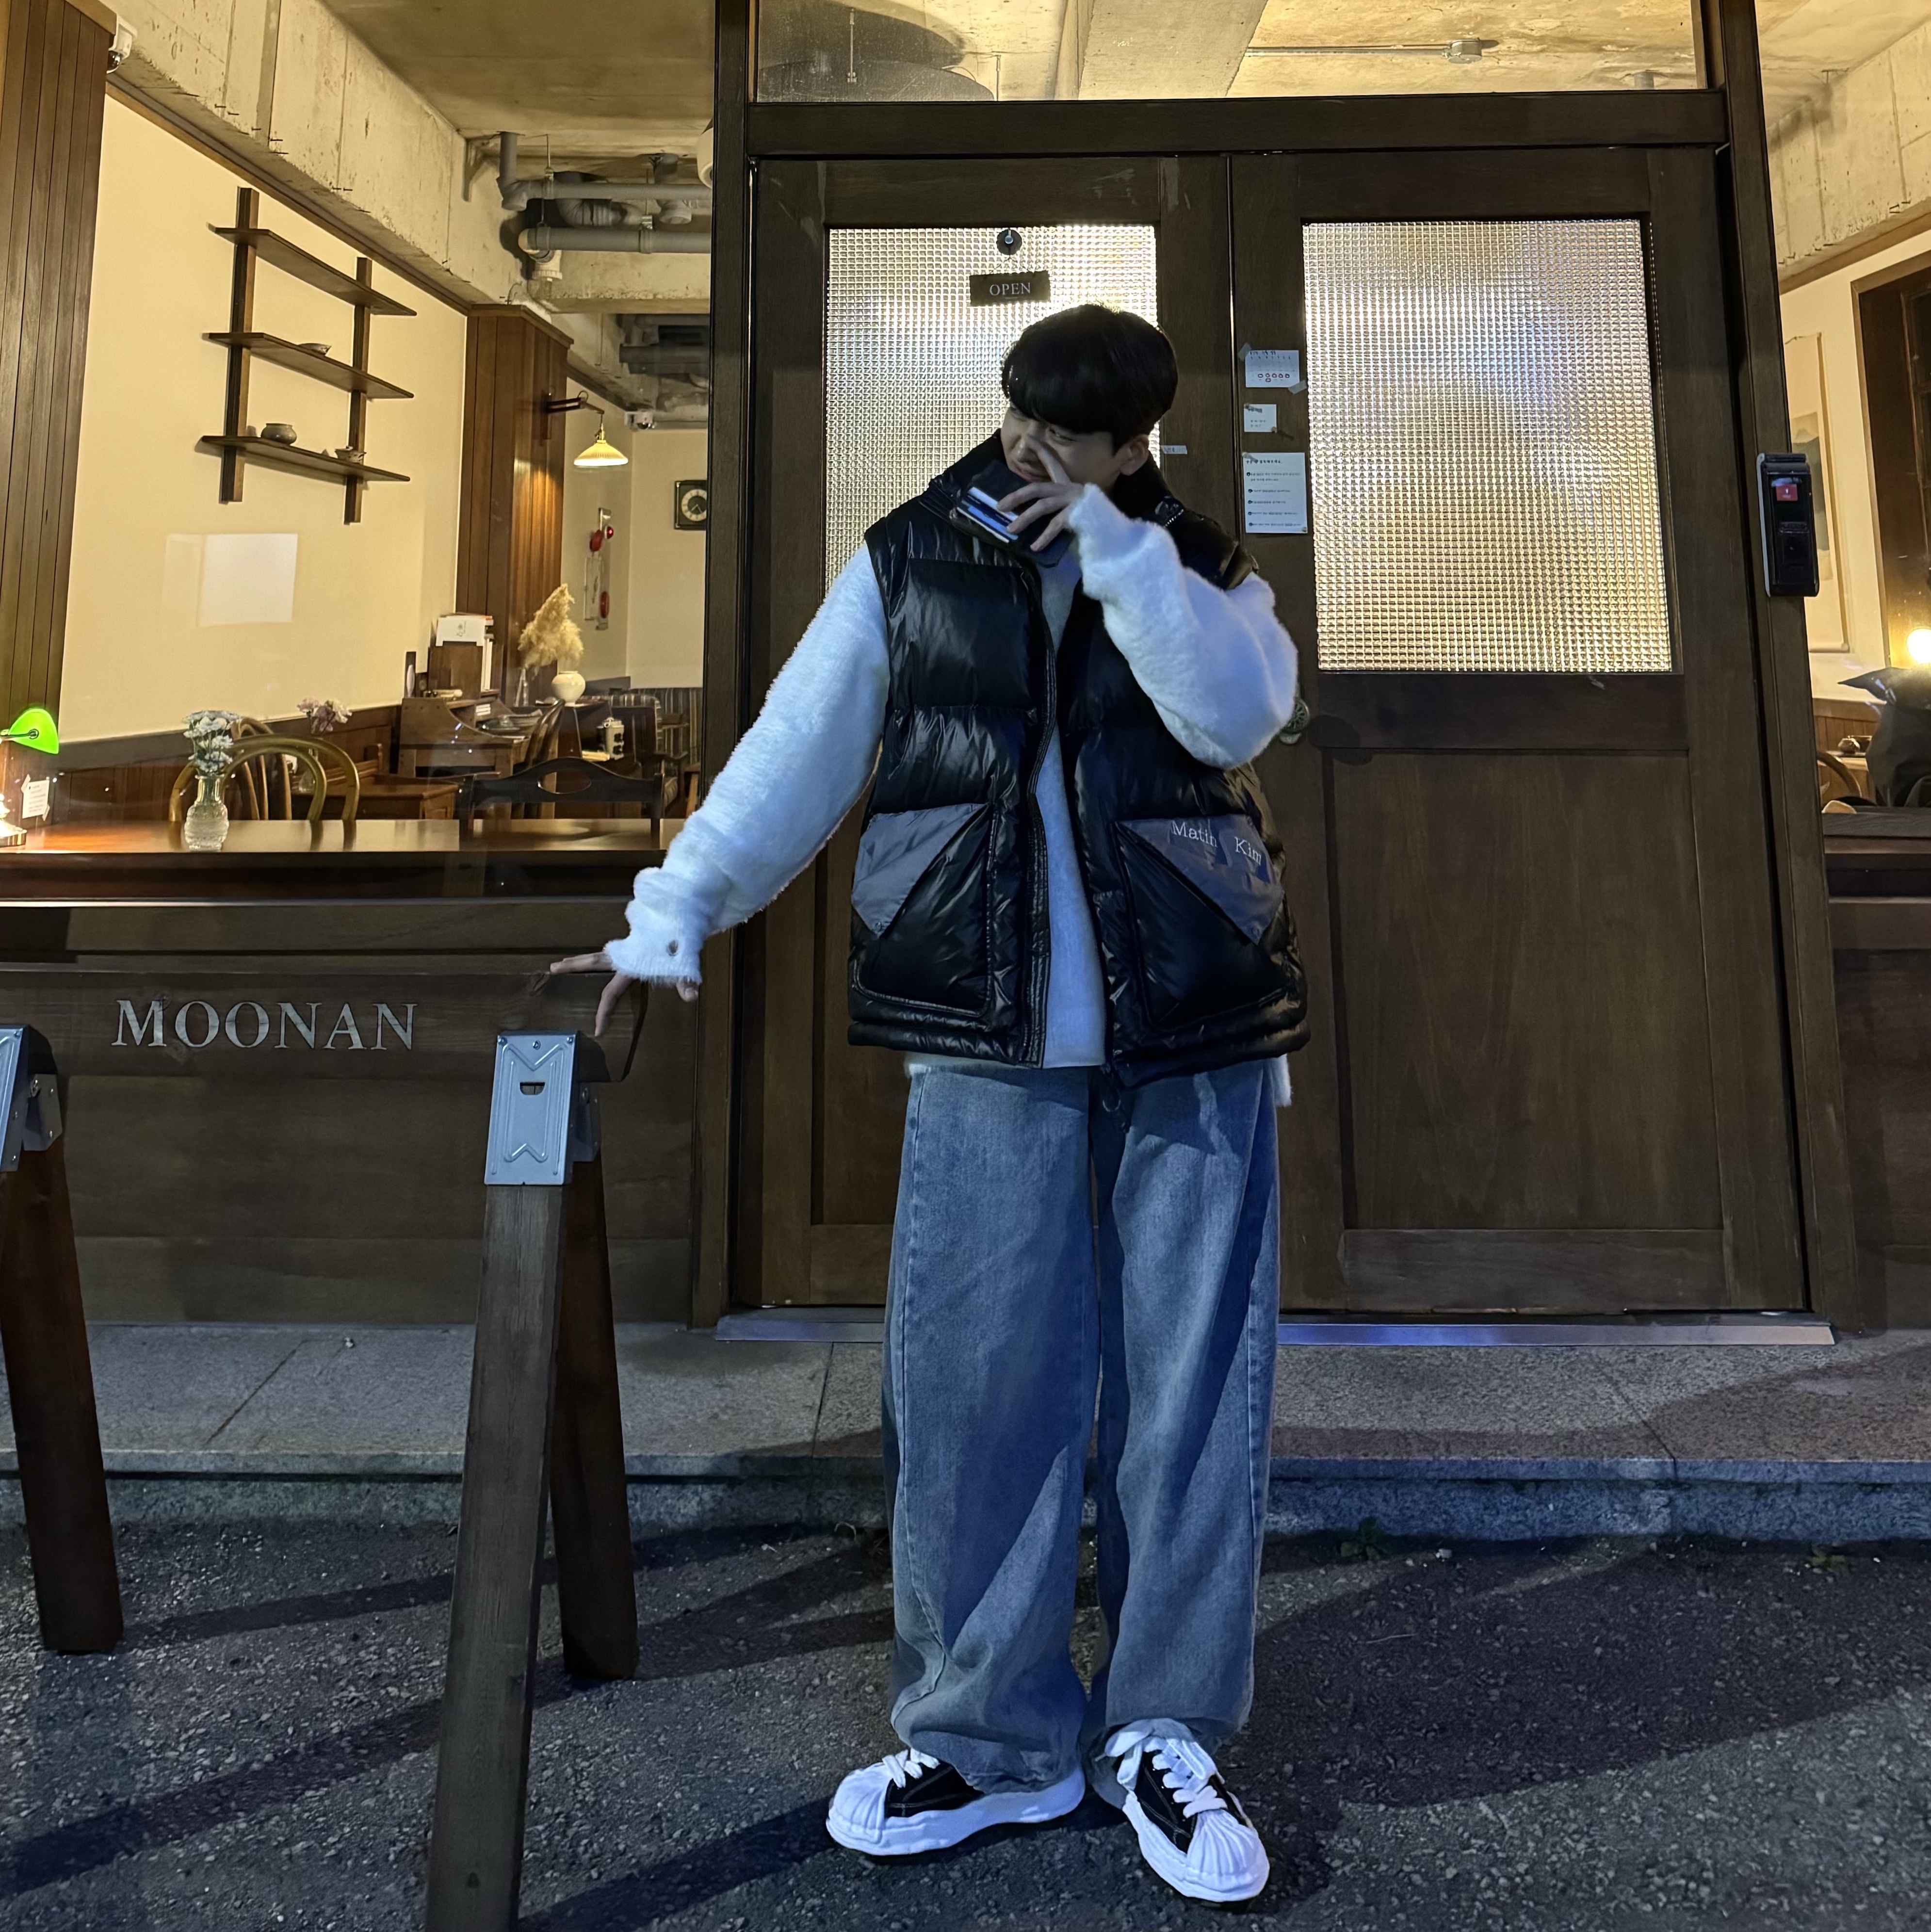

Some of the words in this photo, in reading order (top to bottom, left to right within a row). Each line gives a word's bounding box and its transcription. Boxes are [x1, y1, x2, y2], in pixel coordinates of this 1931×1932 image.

[990, 282, 1031, 296] OPEN
[1171, 820, 1217, 847] Matin
[1234, 836, 1262, 865] Kim
[111, 999, 418, 1050] MOONAN
